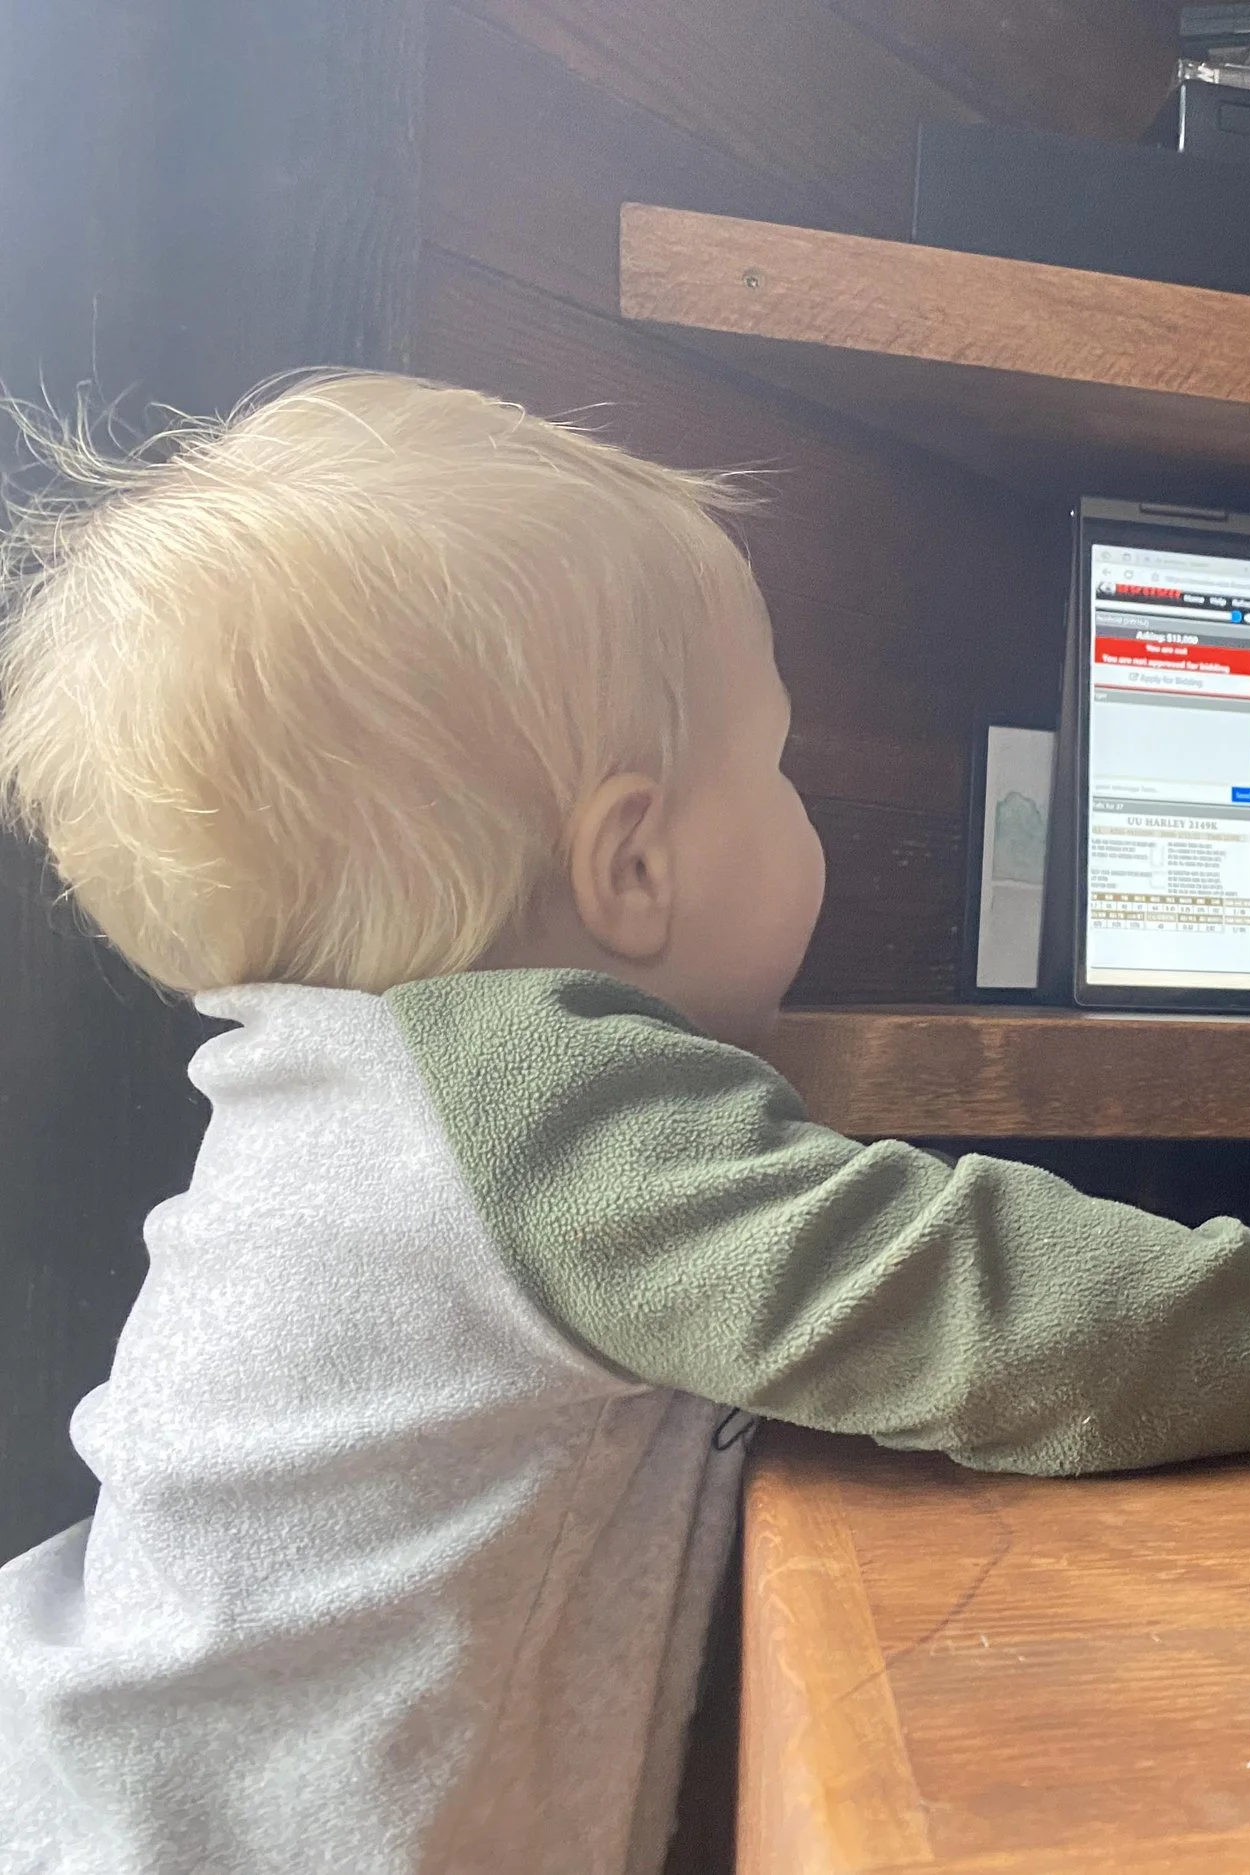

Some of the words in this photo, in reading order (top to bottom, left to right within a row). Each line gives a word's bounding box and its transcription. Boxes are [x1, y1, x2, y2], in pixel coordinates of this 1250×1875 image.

[1136, 630, 1165, 643] Asking:
[1146, 643, 1160, 653] You
[1102, 653, 1118, 663] You
[1119, 656, 1132, 664] are
[1149, 659, 1185, 670] approved
[1186, 660, 1199, 669] for
[1200, 662, 1230, 674] bidding
[1127, 816, 1143, 826] UU
[1145, 817, 1186, 829] HARLEY
[1188, 821, 1218, 831] 2149K
